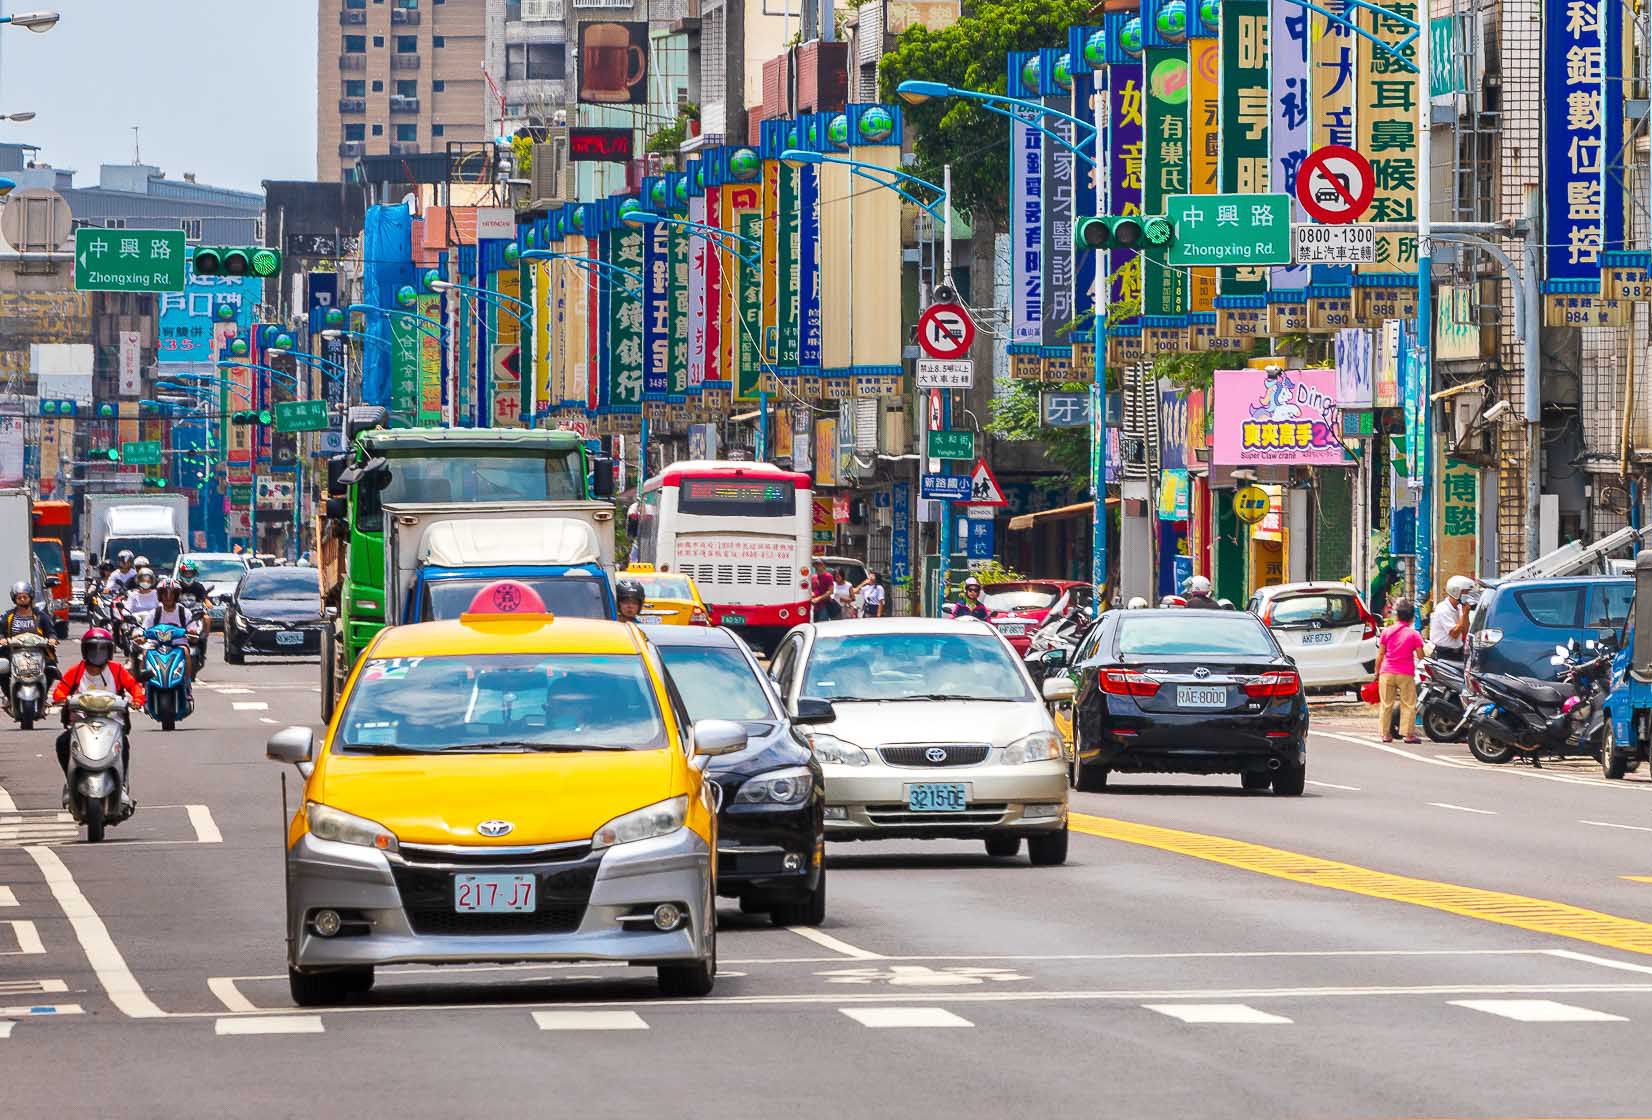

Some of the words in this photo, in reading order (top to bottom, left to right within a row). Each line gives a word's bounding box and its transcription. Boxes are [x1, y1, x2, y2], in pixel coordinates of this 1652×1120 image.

[1183, 204, 1274, 229] 中興路
[88, 237, 172, 259] 中興路
[1183, 242, 1252, 259] Zhongxing
[1255, 242, 1275, 255] Rd.
[1299, 245, 1372, 261] 禁止汽車左轉
[88, 271, 150, 288] Zhongxing
[153, 272, 171, 285] Rd.
